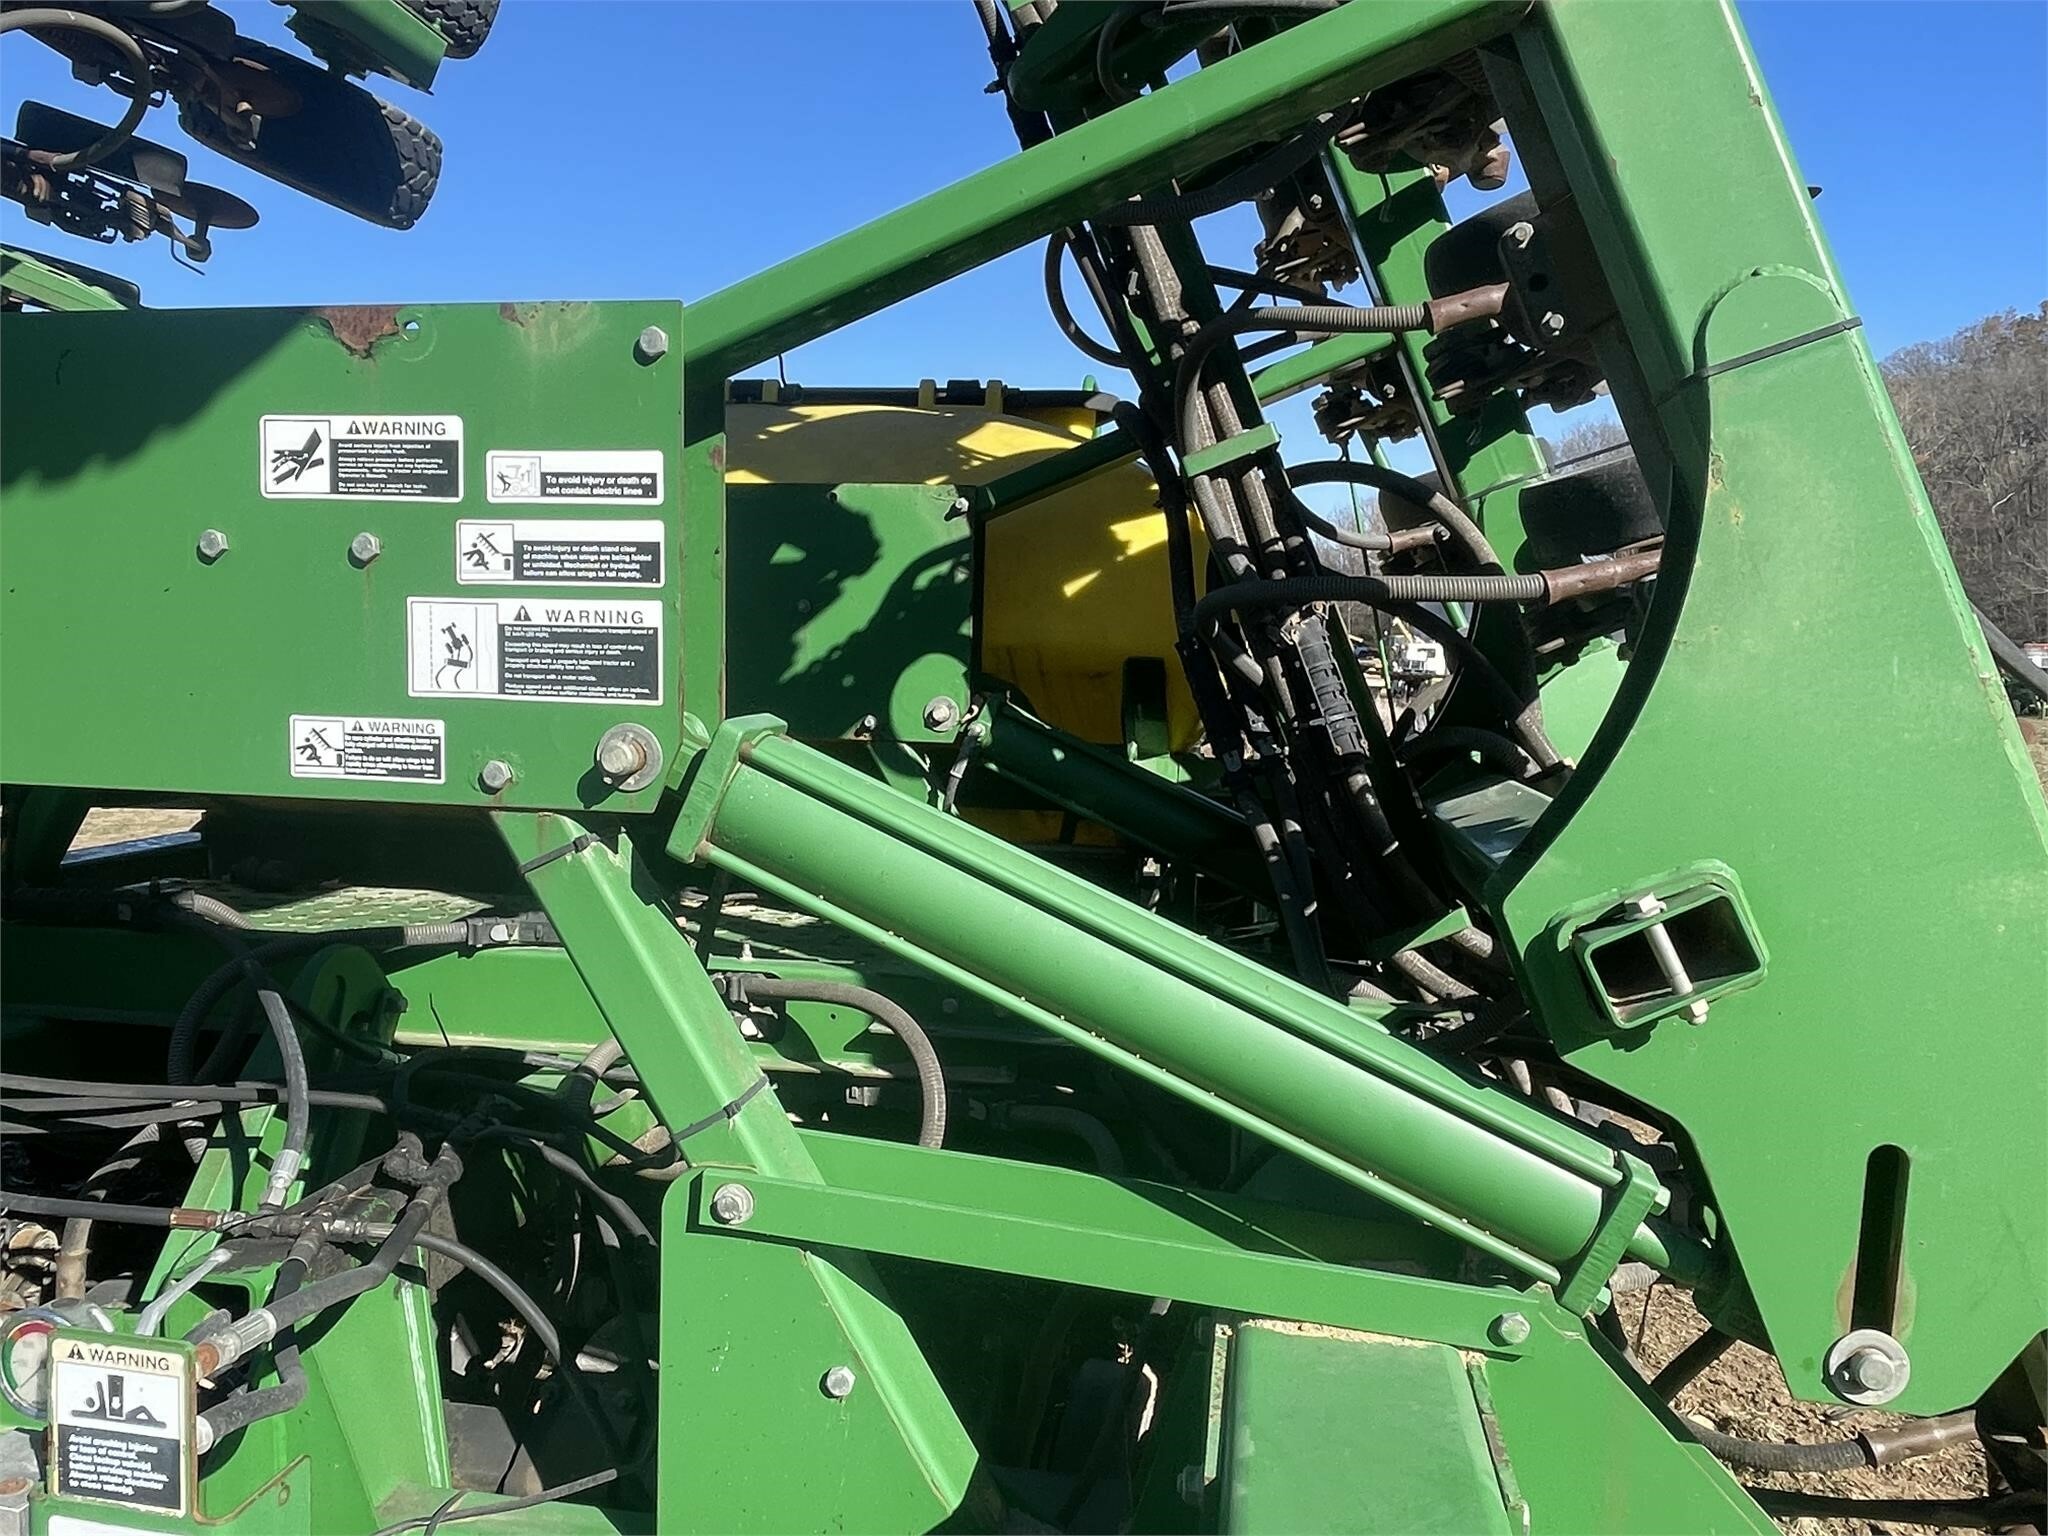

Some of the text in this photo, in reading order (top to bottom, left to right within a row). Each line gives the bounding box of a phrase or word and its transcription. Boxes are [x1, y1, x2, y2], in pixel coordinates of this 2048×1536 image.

[362, 421, 446, 435] WARNING
[546, 476, 556, 484] To
[558, 476, 580, 484] avoid
[582, 476, 605, 486] injury
[561, 487, 591, 495] contact
[593, 487, 621, 495] electric
[546, 609, 644, 624] WARNING
[368, 721, 436, 734] WARNING
[89, 1348, 169, 1371] WARNING
